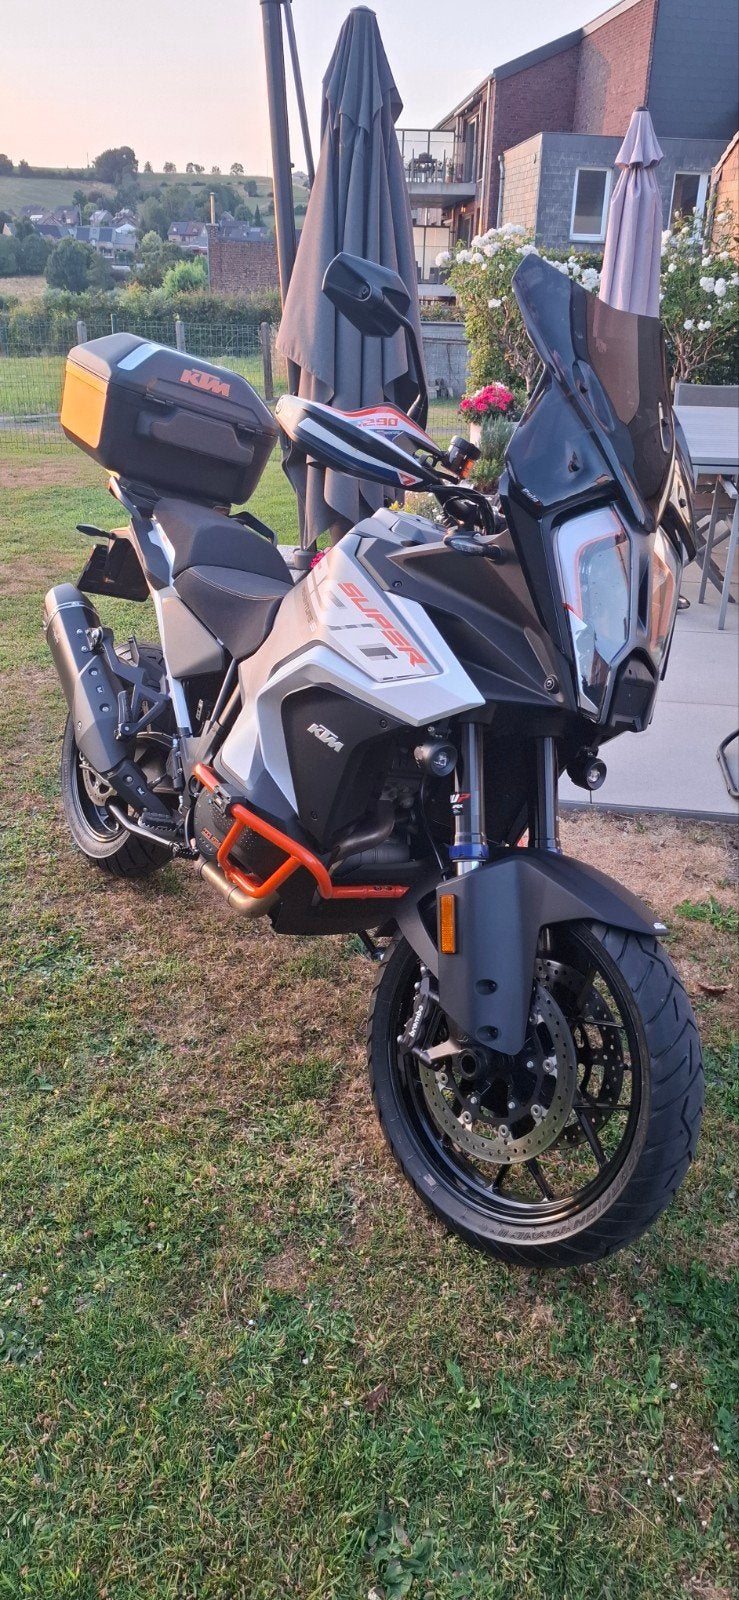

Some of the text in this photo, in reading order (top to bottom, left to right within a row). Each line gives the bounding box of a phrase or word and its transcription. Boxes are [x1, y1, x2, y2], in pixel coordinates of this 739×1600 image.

[180, 368, 231, 397] KTM
[337, 582, 428, 667] SUPER
[306, 723, 345, 753] KTM
[409, 1005, 424, 1038] brembo
